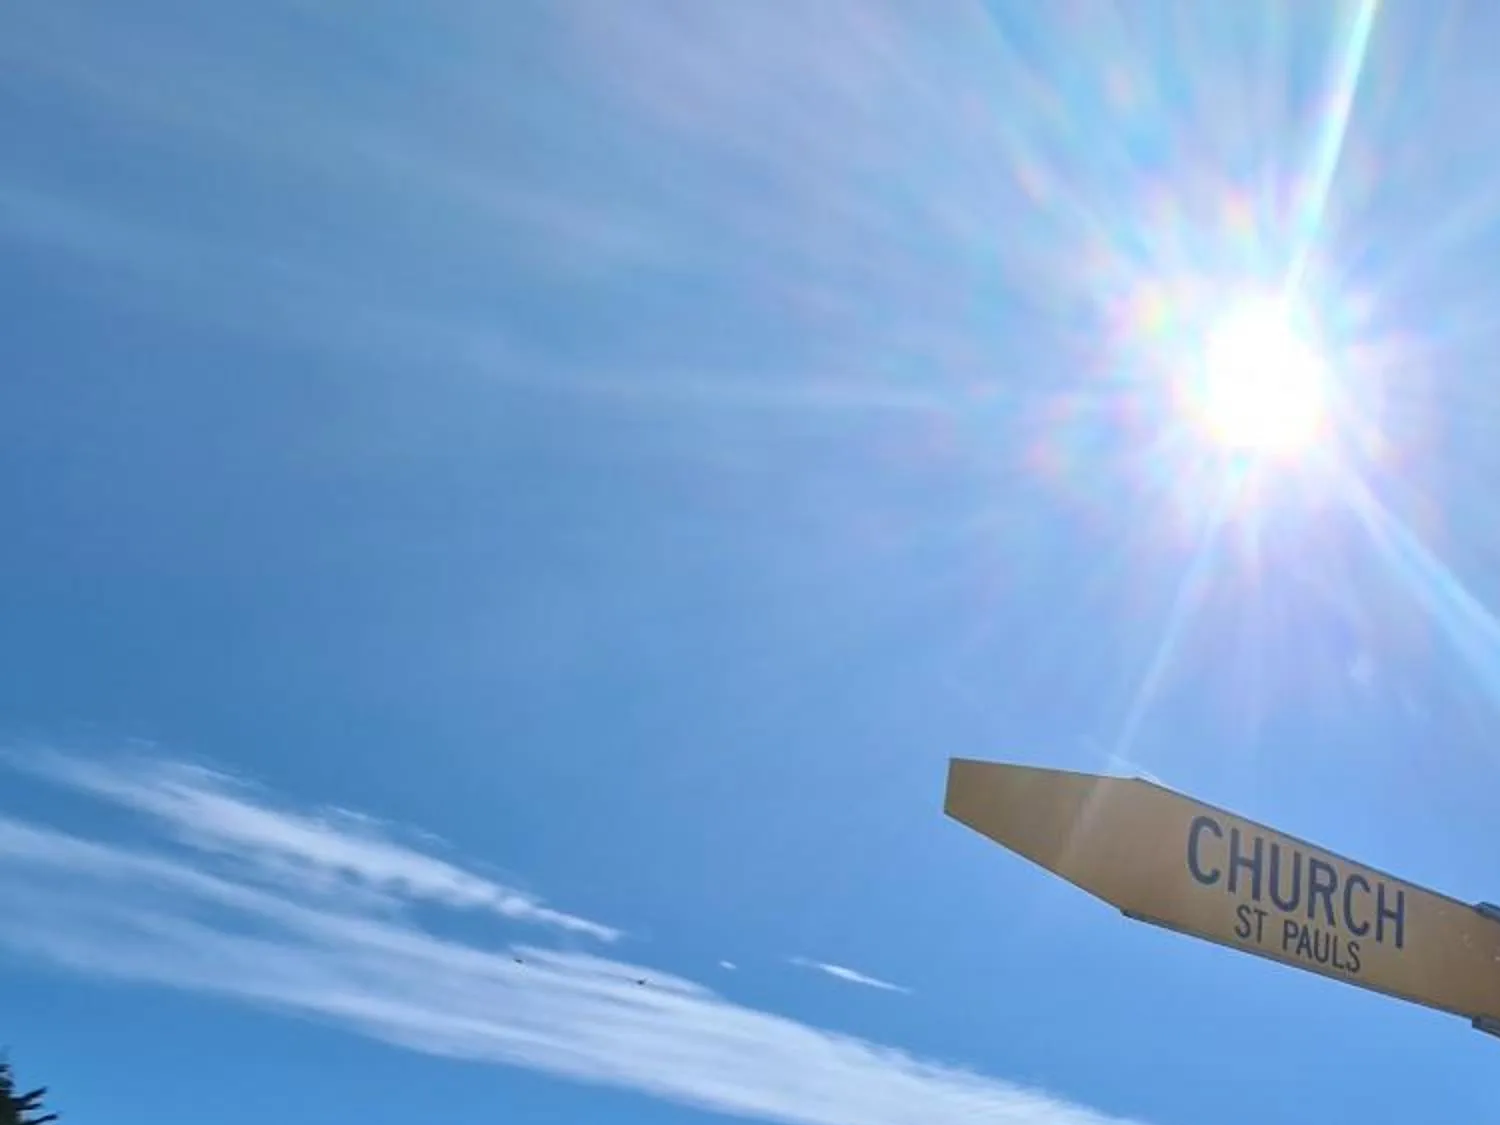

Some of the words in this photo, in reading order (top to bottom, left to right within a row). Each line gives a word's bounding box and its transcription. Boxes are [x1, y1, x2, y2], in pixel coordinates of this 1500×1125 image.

[1187, 815, 1405, 949] CHURCH
[1234, 904, 1268, 944] ST
[1282, 919, 1361, 974] PAULS
